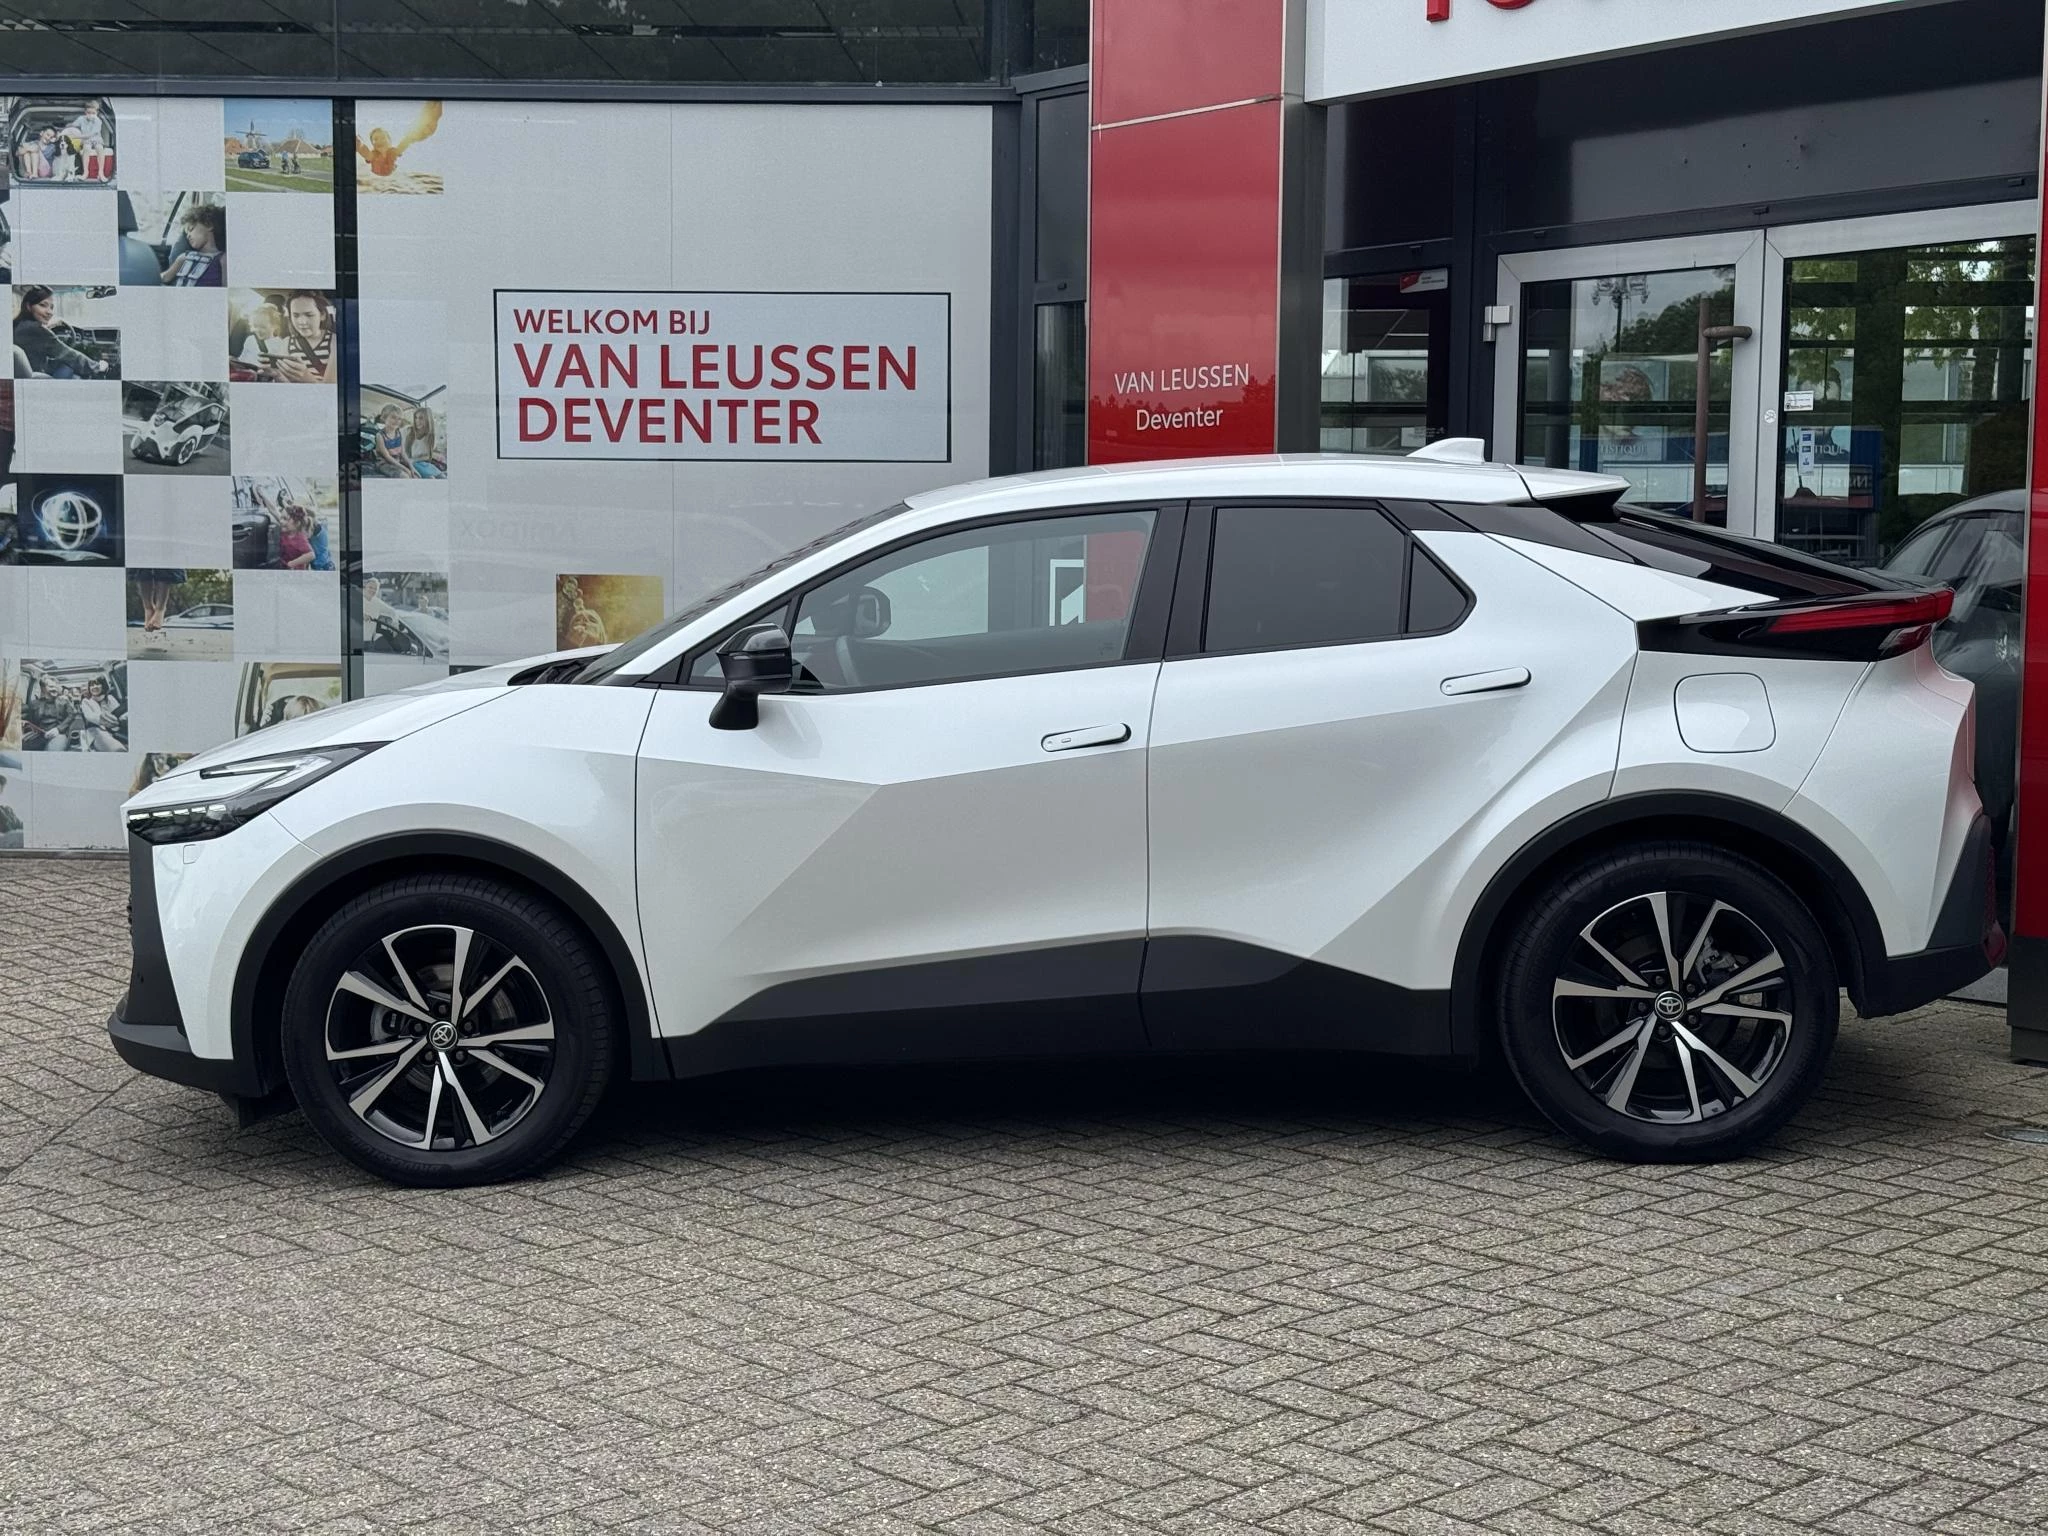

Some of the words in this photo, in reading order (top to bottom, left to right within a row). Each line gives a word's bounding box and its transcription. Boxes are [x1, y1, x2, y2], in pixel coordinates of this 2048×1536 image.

[513, 309, 658, 334] WELKOM
[670, 310, 711, 335] BIJ
[513, 343, 638, 389] VAN
[660, 344, 917, 391] LEUSSEN
[1114, 370, 1154, 394] VAN
[1161, 363, 1249, 391] LEUSSEN
[518, 397, 823, 445] DEVENTER
[1136, 407, 1224, 431] Deventer
